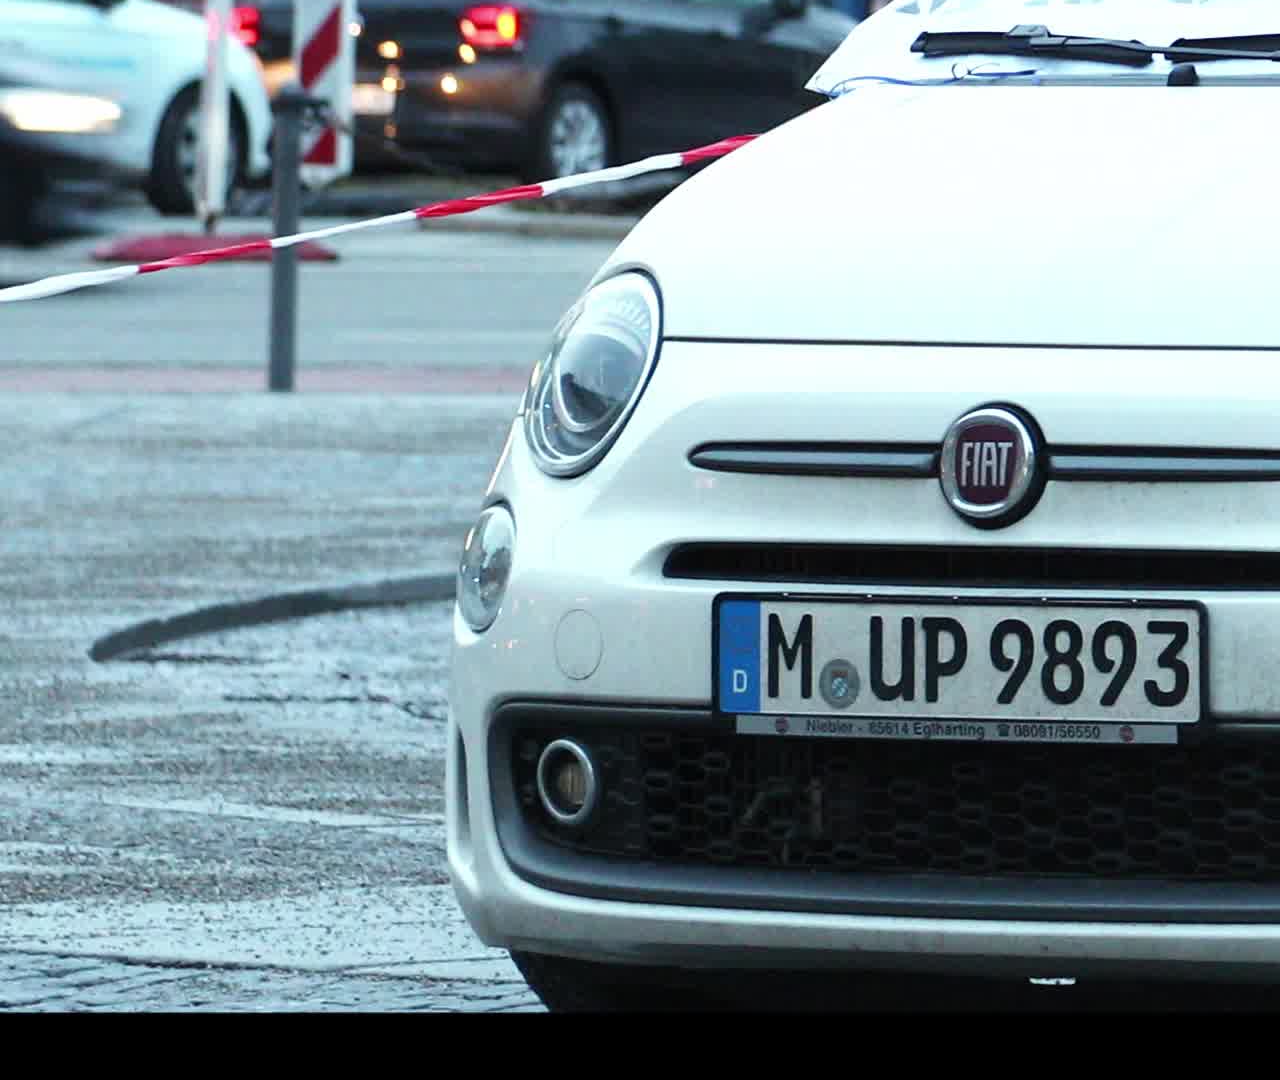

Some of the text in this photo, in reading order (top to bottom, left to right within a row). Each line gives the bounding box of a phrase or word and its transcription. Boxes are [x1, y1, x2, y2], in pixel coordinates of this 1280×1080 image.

[960, 439, 1013, 489] FIAT
[767, 613, 1191, 707] M UP 9893
[732, 669, 748, 693] D
[913, 723, 985, 739] Eglharting
